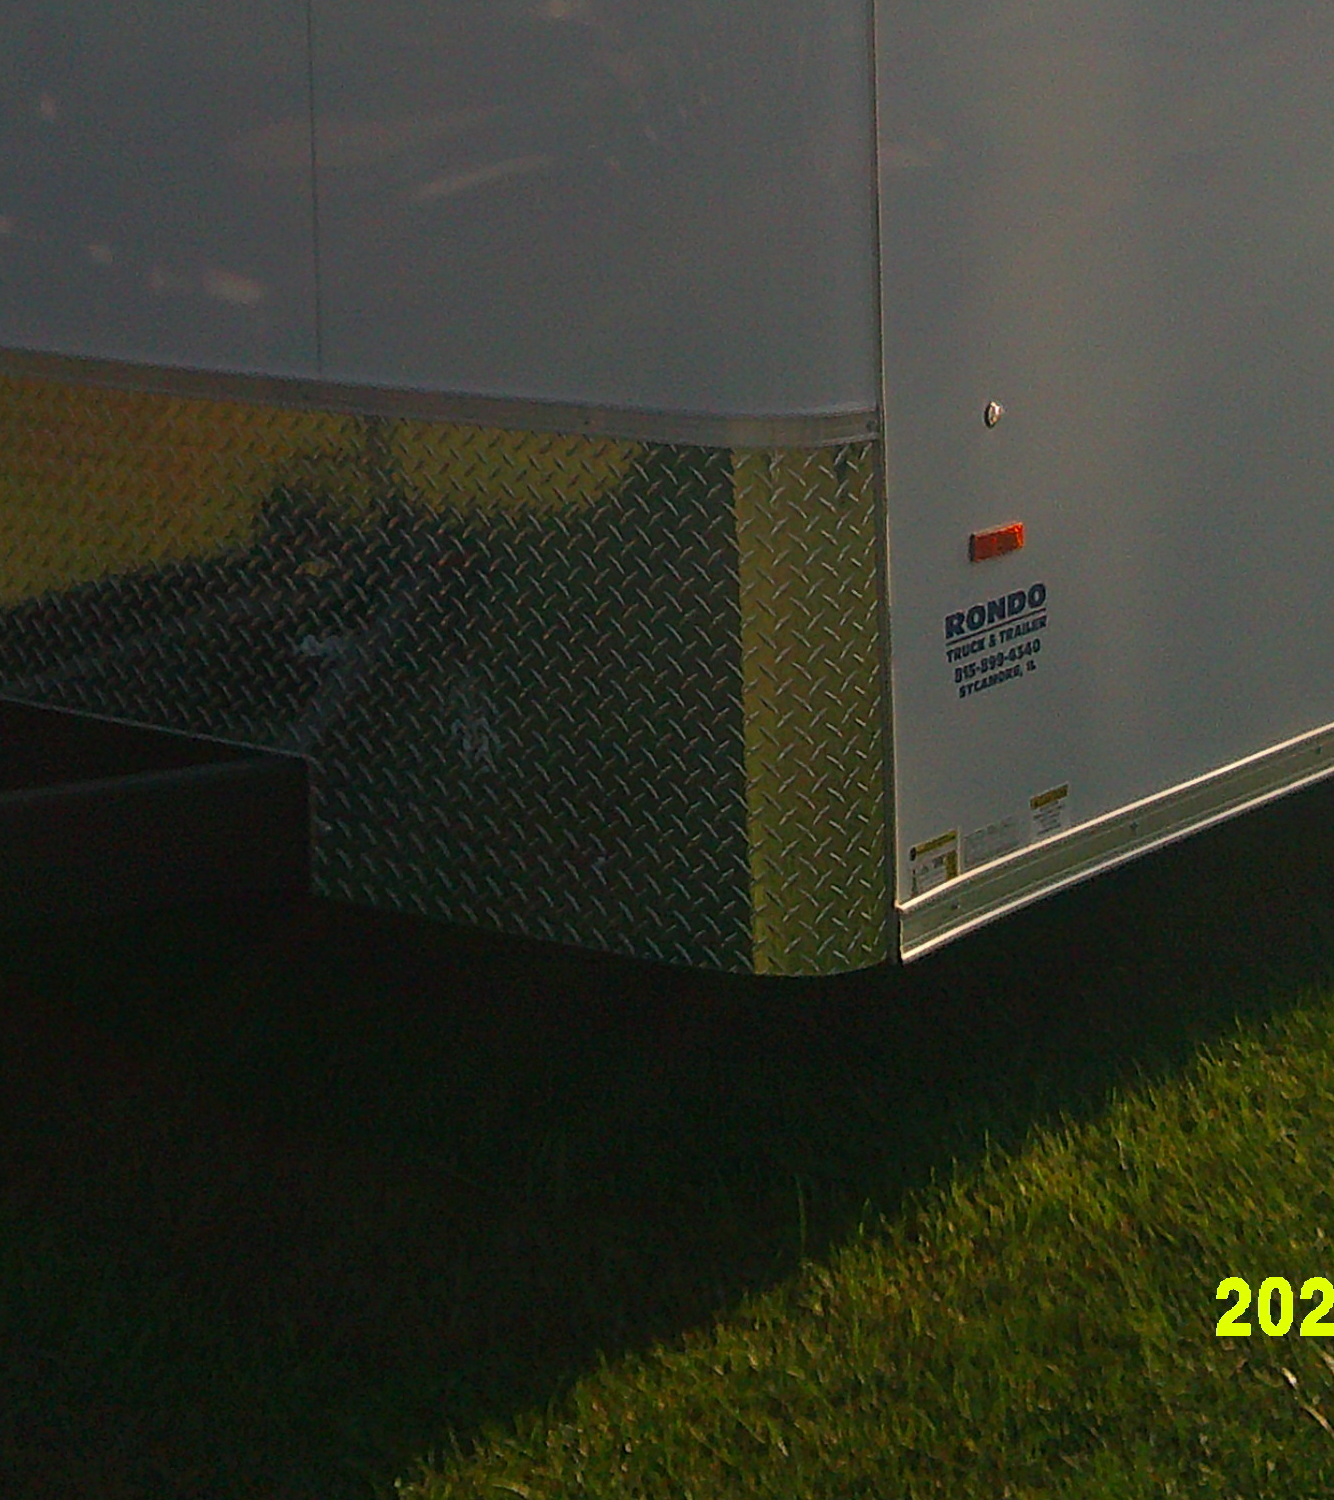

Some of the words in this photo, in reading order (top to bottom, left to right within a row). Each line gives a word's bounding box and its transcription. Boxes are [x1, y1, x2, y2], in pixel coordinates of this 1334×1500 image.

[945, 582, 1047, 639] RONDO
[945, 637, 986, 663] TRUCK
[988, 634, 997, 648] &
[999, 615, 1047, 644] TRAILER
